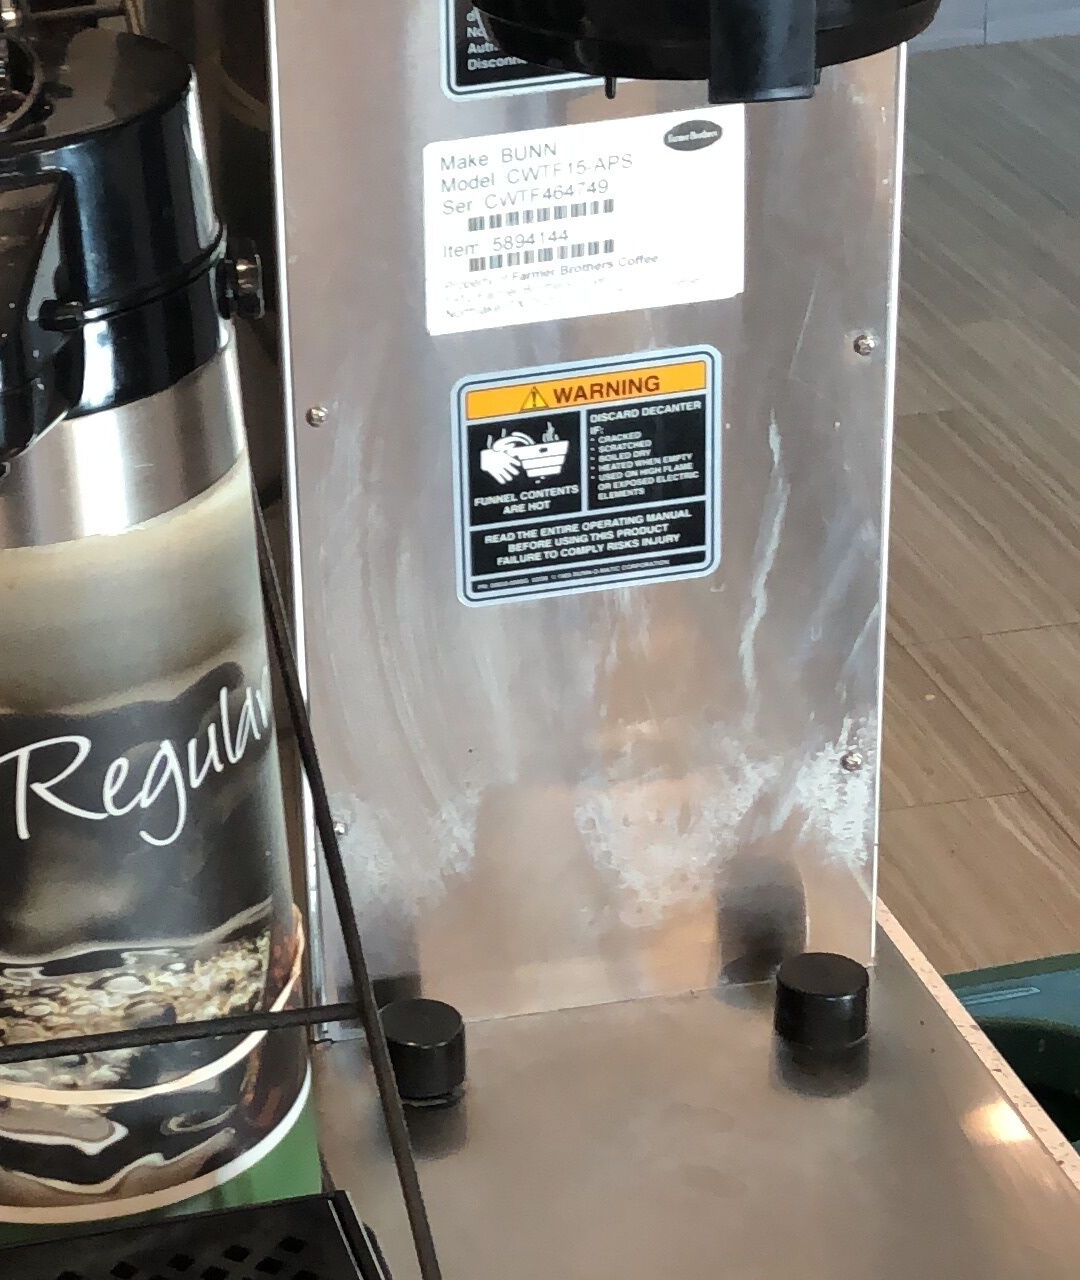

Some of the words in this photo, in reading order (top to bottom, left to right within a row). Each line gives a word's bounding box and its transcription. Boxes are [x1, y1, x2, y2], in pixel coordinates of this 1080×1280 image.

[440, 153, 489, 171] Make
[501, 142, 557, 163] BUNN
[441, 172, 495, 192] Model
[442, 199, 472, 215] Ser
[618, 254, 659, 267] Coffee
[553, 375, 661, 404] WARNING
[589, 408, 640, 423] DISCARD
[641, 400, 702, 416] DECANTER
[662, 452, 694, 463] EMPTY
[473, 493, 518, 507] FUNNEL
[519, 484, 579, 500] CONTENTS
[502, 503, 526, 515] ARE
[527, 500, 551, 511] HOT
[484, 532, 516, 544] READ
[516, 529, 538, 539] THE
[540, 523, 580, 537] ENTIRE
[581, 515, 644, 531] OPERATING
[645, 509, 692, 521] MANUAL
[507, 539, 553, 553] BEFORE
[554, 534, 589, 546] USING
[589, 530, 615, 541] THIS
[616, 523, 670, 538] PRODUCT
[496, 552, 543, 566] FAILURE
[543, 549, 559, 559] TO
[560, 543, 605, 558] COMPLY
[606, 539, 640, 551] RISKS
[641, 533, 681, 546] INJURY
